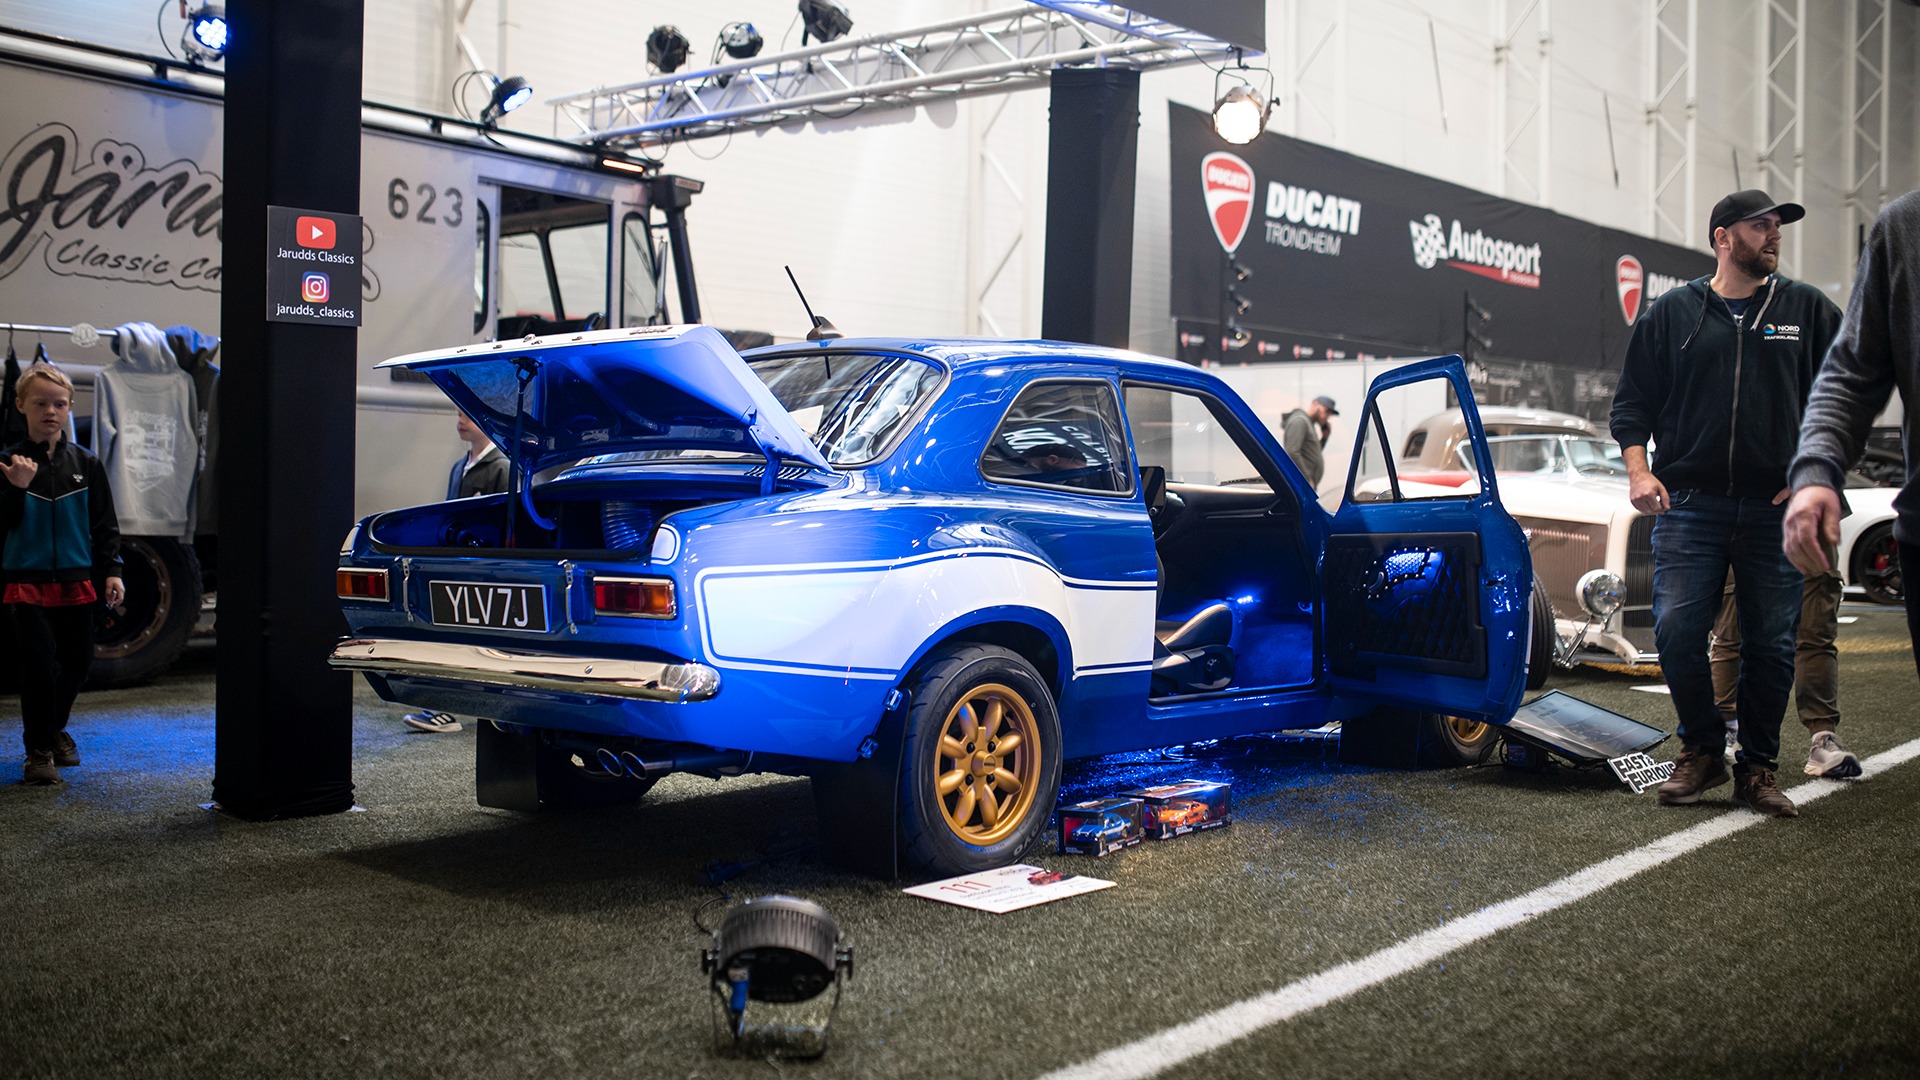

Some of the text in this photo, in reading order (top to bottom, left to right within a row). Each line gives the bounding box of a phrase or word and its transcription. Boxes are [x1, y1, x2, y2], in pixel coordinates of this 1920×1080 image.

[0, 135, 222, 264] Järu
[387, 177, 463, 228] 623
[1265, 180, 1362, 236] DUCATI
[277, 247, 355, 265] Jarudds Classics
[1264, 220, 1342, 256] TRONDHEIM
[1448, 219, 1542, 279] Autosport
[56, 239, 222, 280] Classic Ca
[276, 303, 355, 319] jarudds_classics
[445, 585, 529, 627] YLV7J
[1611, 754, 1648, 779] FAST
[939, 880, 992, 894] 111
